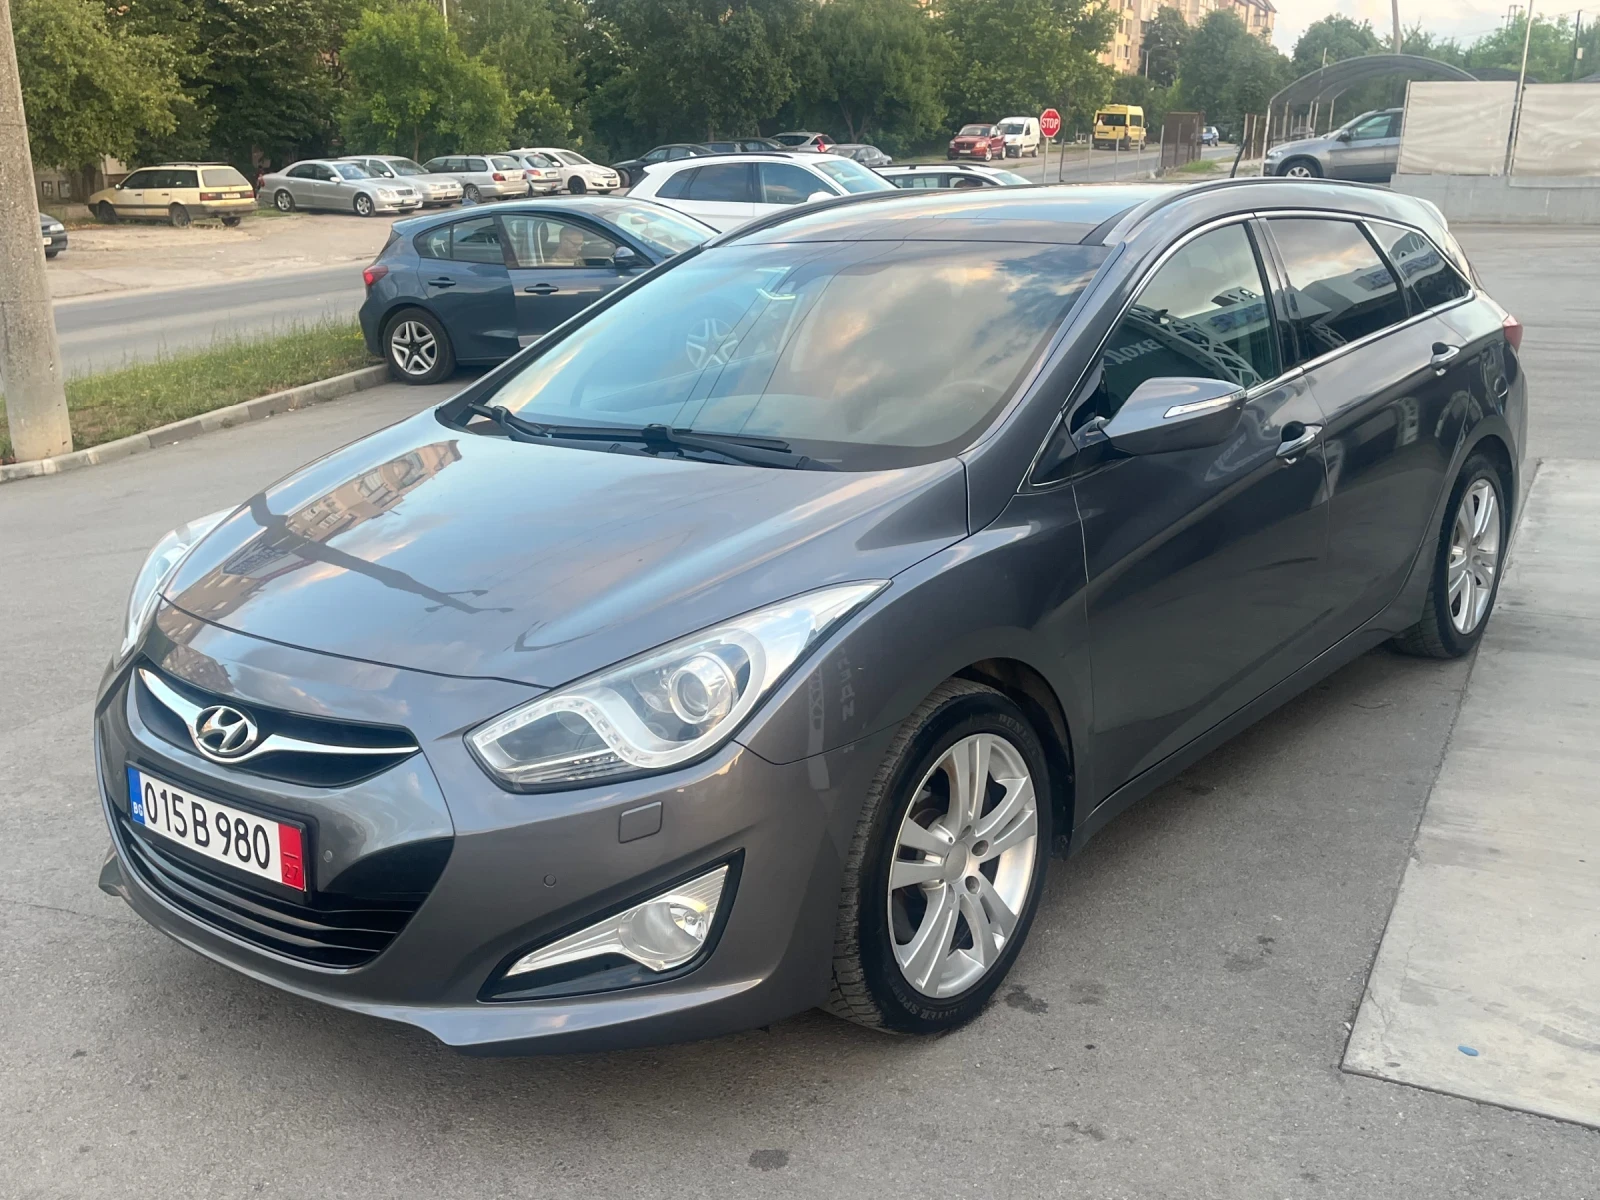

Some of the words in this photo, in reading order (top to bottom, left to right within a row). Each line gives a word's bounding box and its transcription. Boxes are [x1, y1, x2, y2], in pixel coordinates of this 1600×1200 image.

[1042, 118, 1059, 129] STOP
[133, 801, 143, 816] BG
[284, 862, 299, 880] 27
